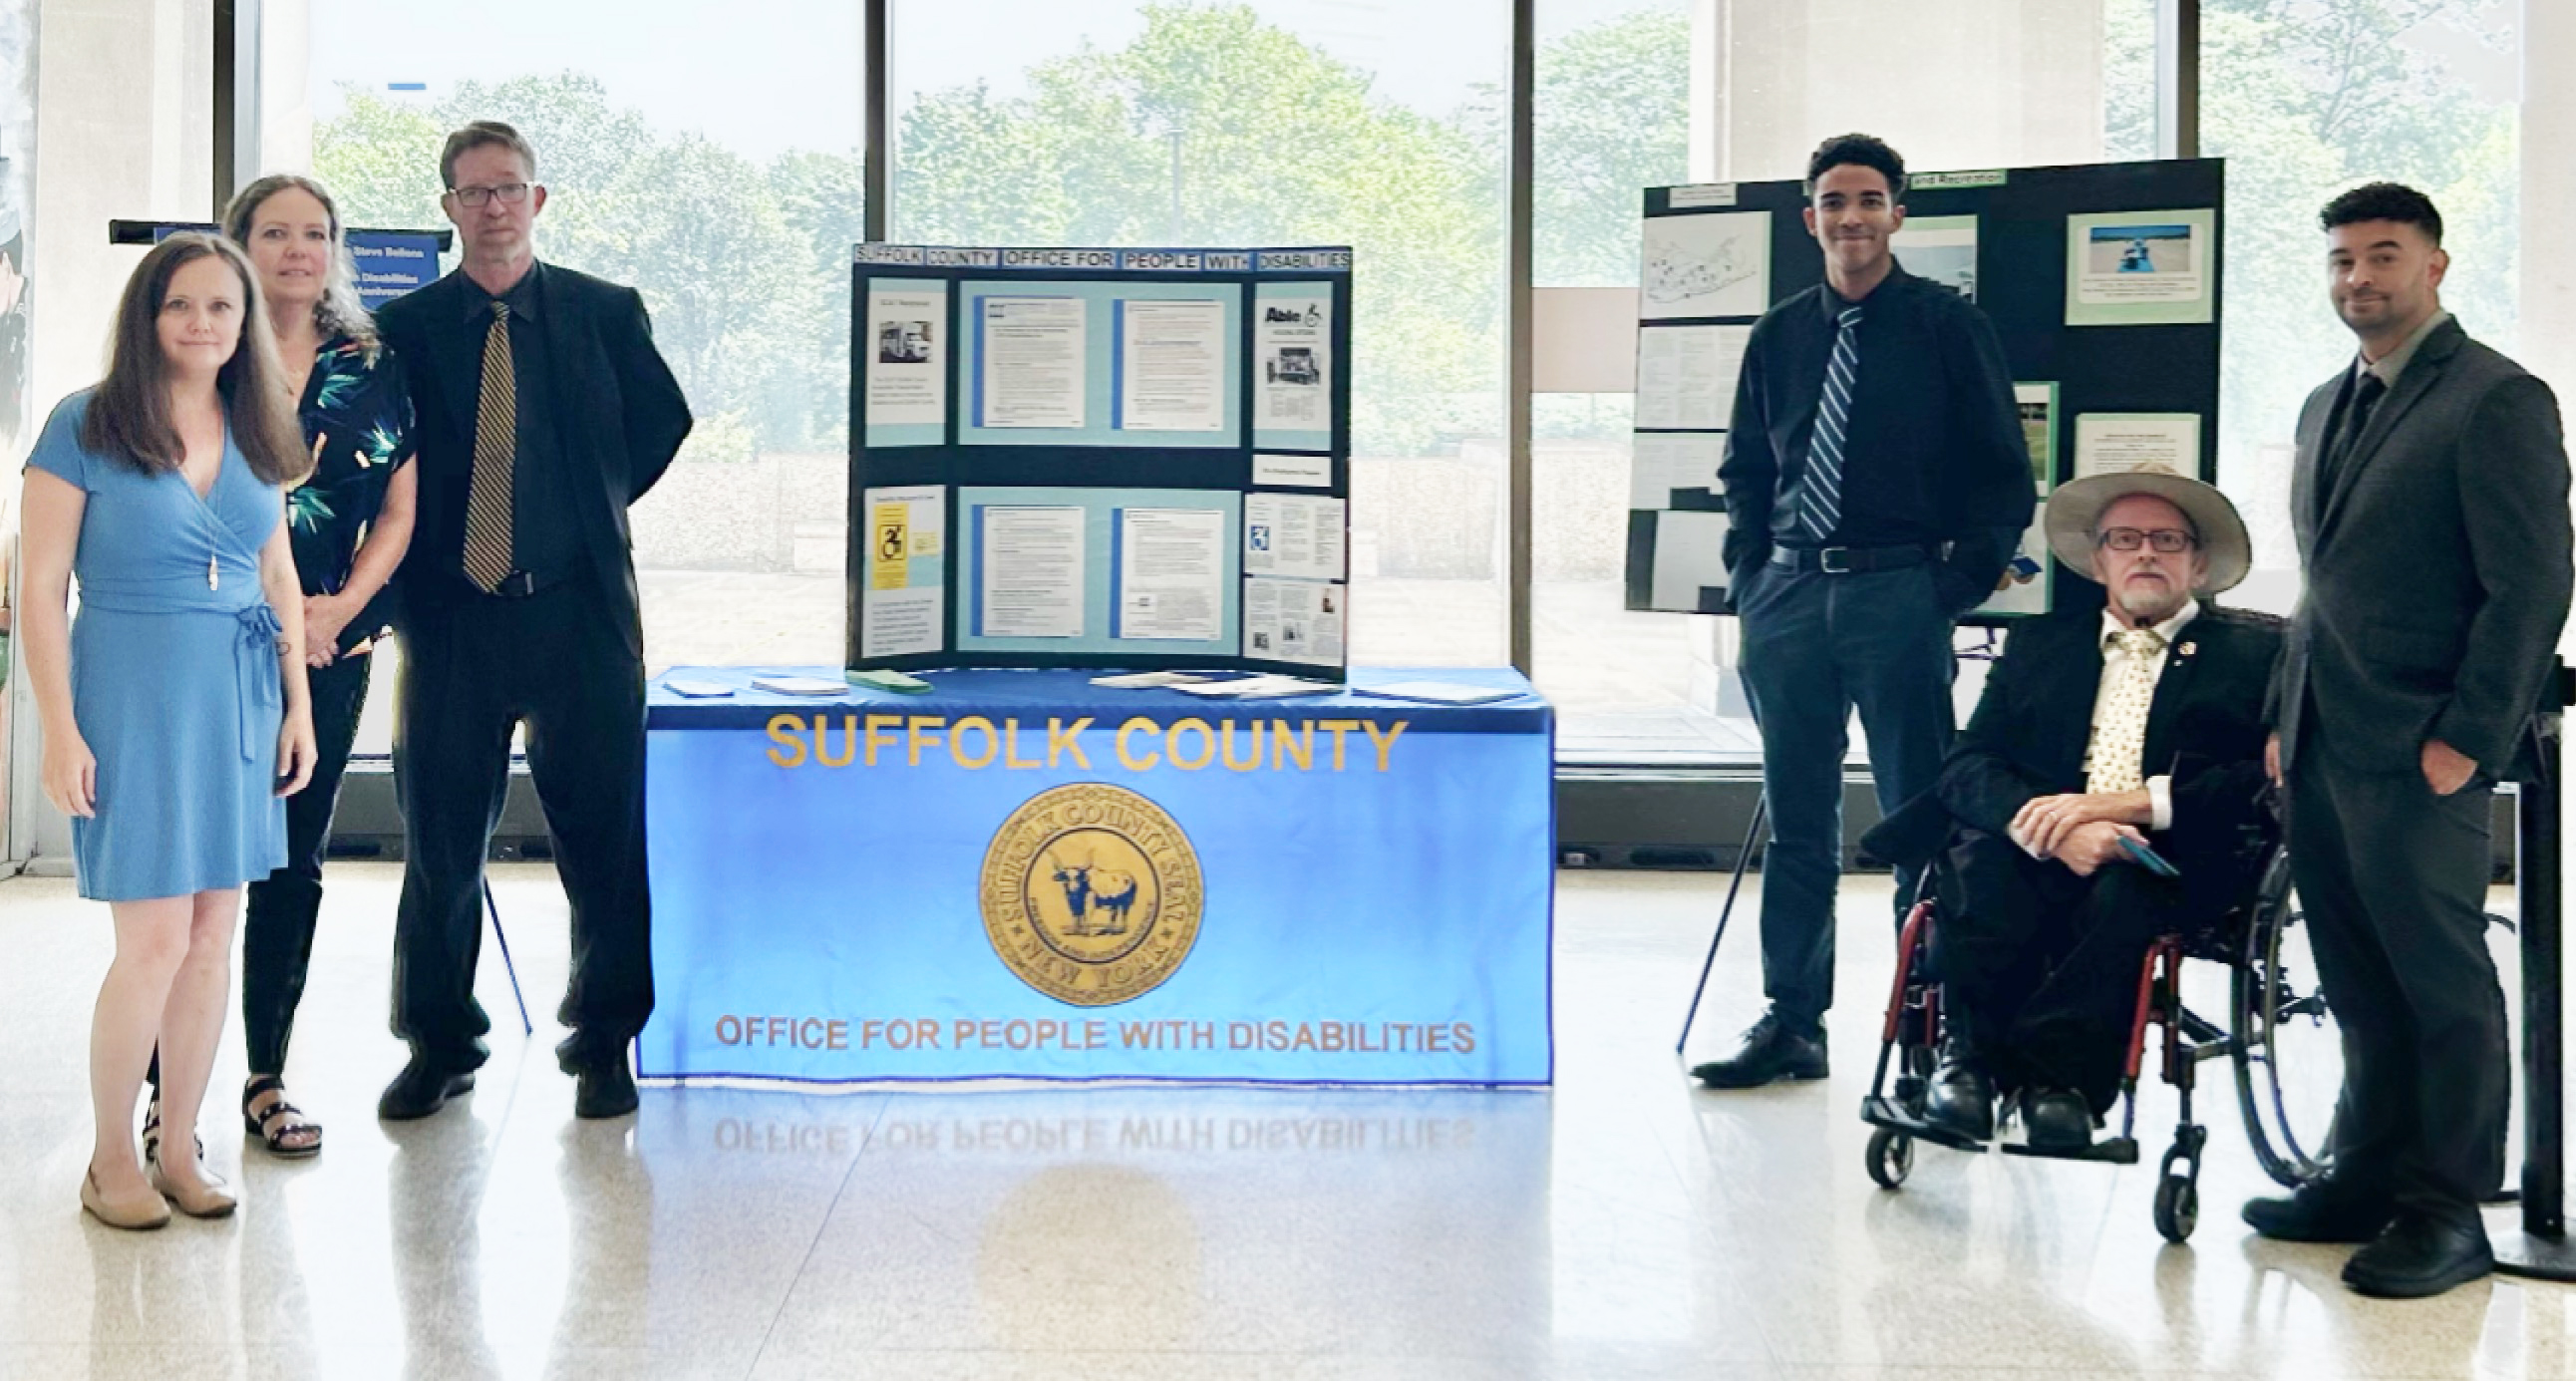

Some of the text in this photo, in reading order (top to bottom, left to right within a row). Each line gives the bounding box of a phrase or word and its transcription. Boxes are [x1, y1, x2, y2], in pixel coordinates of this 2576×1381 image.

[856, 245, 1351, 270] SUFFOLK COUNTY OFFICE FOR PEOPLE WITH DISABILITIES
[765, 712, 1409, 772] SUFFOLK COUNTY
[999, 802, 1189, 923] SUFFOLK COUNTY SEAL
[1019, 939, 1171, 988] NEW YORK
[715, 1014, 1476, 1054] OFFICE FOR PEOPLE WITH DISABILITIES
